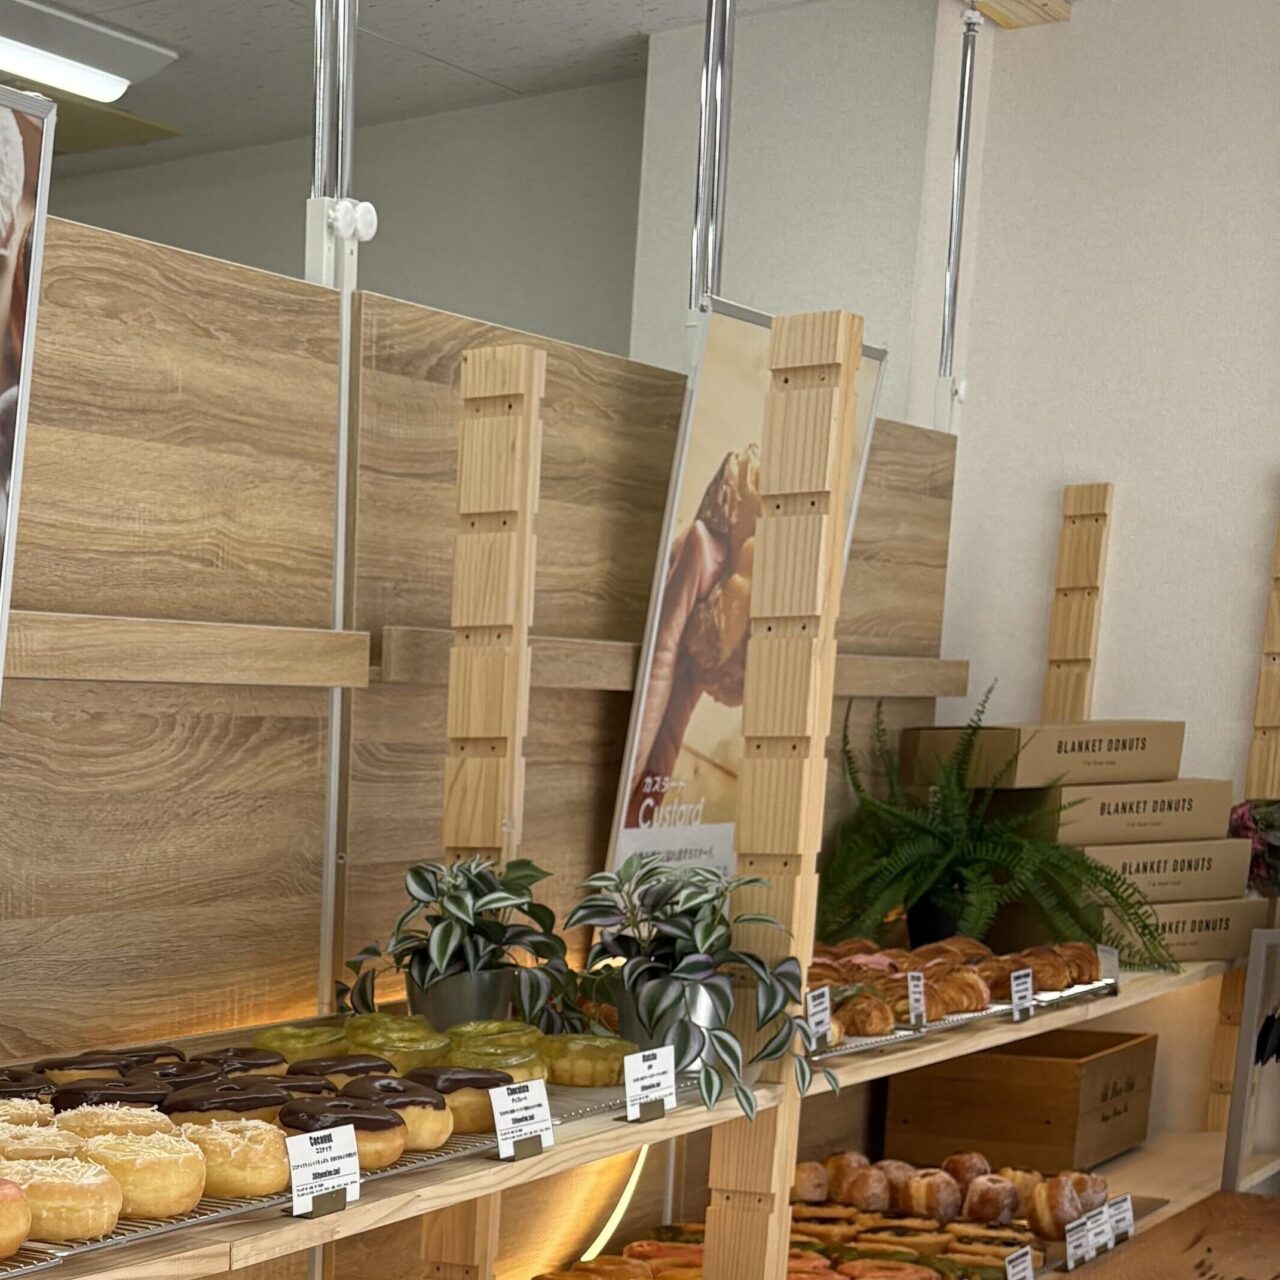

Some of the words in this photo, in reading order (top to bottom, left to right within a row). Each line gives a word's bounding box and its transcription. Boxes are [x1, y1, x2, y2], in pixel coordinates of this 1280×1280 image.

[1056, 738, 1103, 755] BLANKET
[1106, 737, 1147, 752] DONUTS
[639, 796, 705, 828] Custard
[1099, 800, 1148, 816] BLANKET
[1151, 798, 1194, 813] DONUTS
[1121, 859, 1168, 875] BLANKET
[1172, 857, 1213, 872] DONUTS
[1190, 917, 1231, 933] DONUTS
[308, 1133, 334, 1147] Coconut
